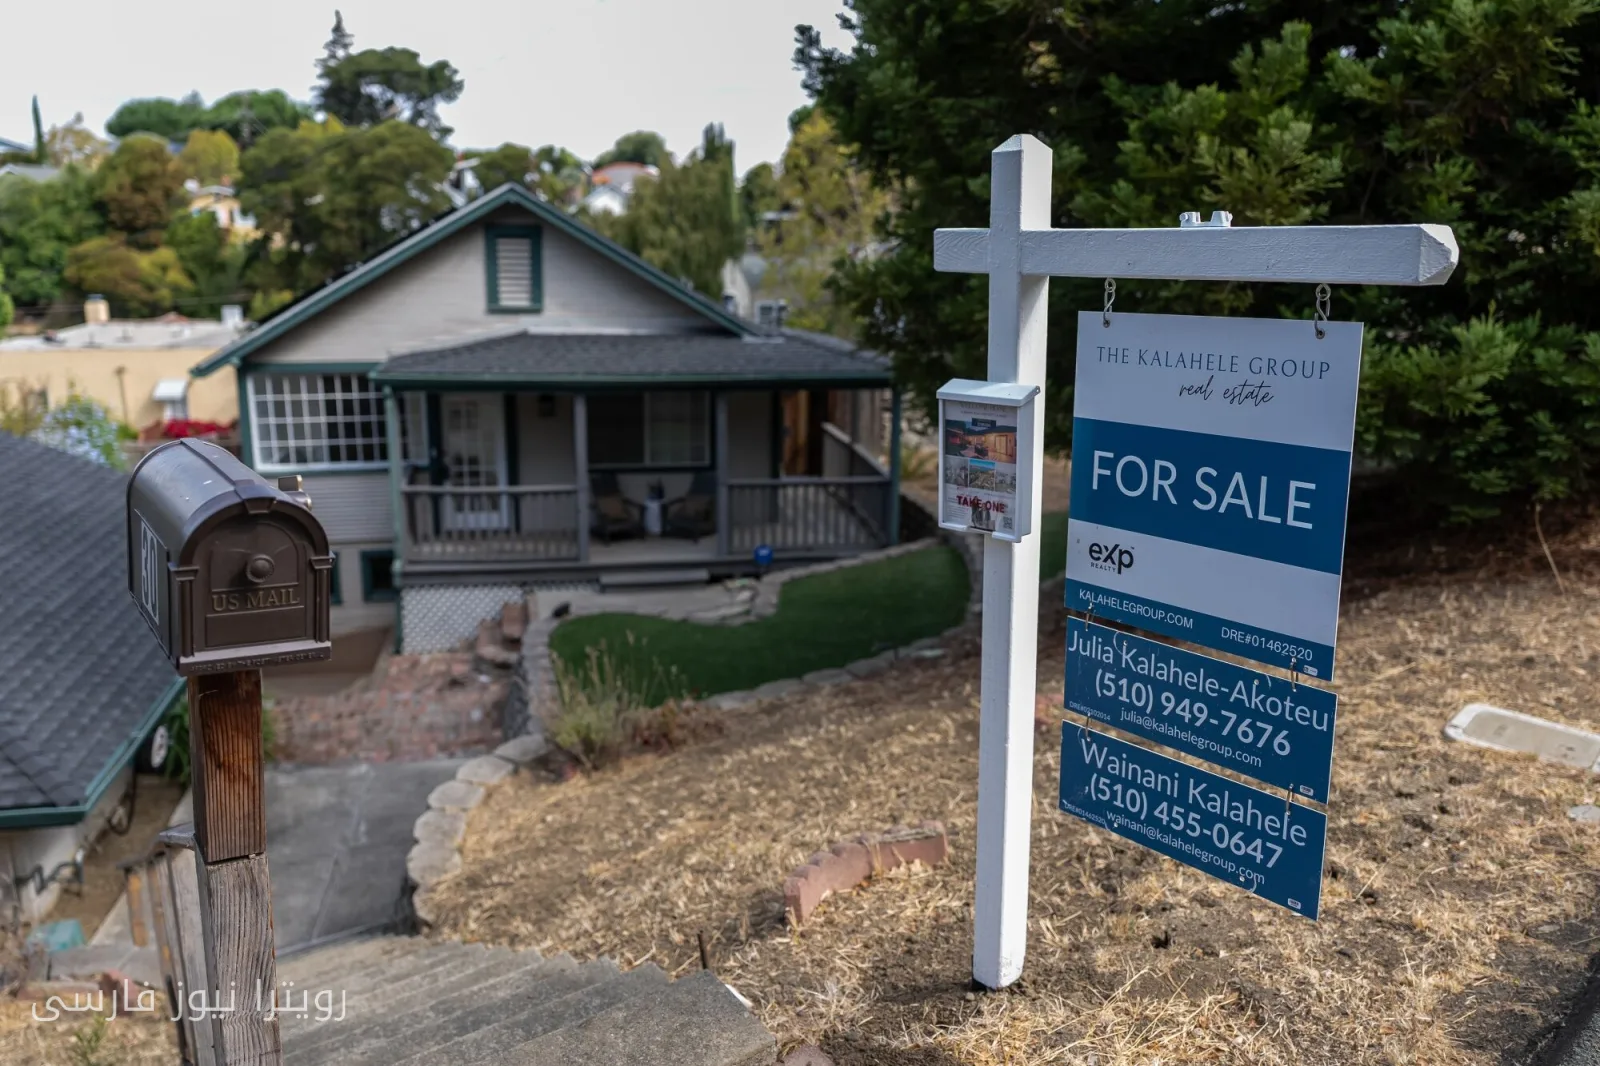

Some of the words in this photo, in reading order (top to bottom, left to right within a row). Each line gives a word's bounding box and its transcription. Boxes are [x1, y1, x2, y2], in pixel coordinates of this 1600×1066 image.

[1096, 346, 1130, 364] THE
[1138, 349, 1240, 374] KALAHELE
[1249, 356, 1331, 380] GROUP
[1178, 375, 1214, 400] real
[1222, 379, 1274, 407] estate
[956, 495, 982, 509] TAKE
[985, 500, 1005, 513] ONE
[1092, 449, 1178, 505] FOR
[1192, 466, 1317, 530] SALE
[1090, 562, 1117, 573] REALTY
[211, 593, 239, 612] US
[245, 588, 300, 609] MAIL
[1079, 588, 1194, 629] KALAHELEGROUP.COM
[1221, 626, 1313, 662] DRE#01462520
[1068, 630, 1114, 664] Julia
[1122, 643, 1328, 732] Kalahele-Akoteu
[1095, 668, 1154, 714] (510)
[1161, 692, 1292, 756] 949-7676
[1119, 707, 1262, 768] julia@kalahelegroup.com
[1081, 737, 1179, 799] Wainani
[1188, 777, 1308, 847] Kalahele
[1090, 773, 1148, 820] (510)
[1153, 801, 1283, 868] 455-0647
[1106, 810, 1265, 885] wainani@kalahelegroup.com
